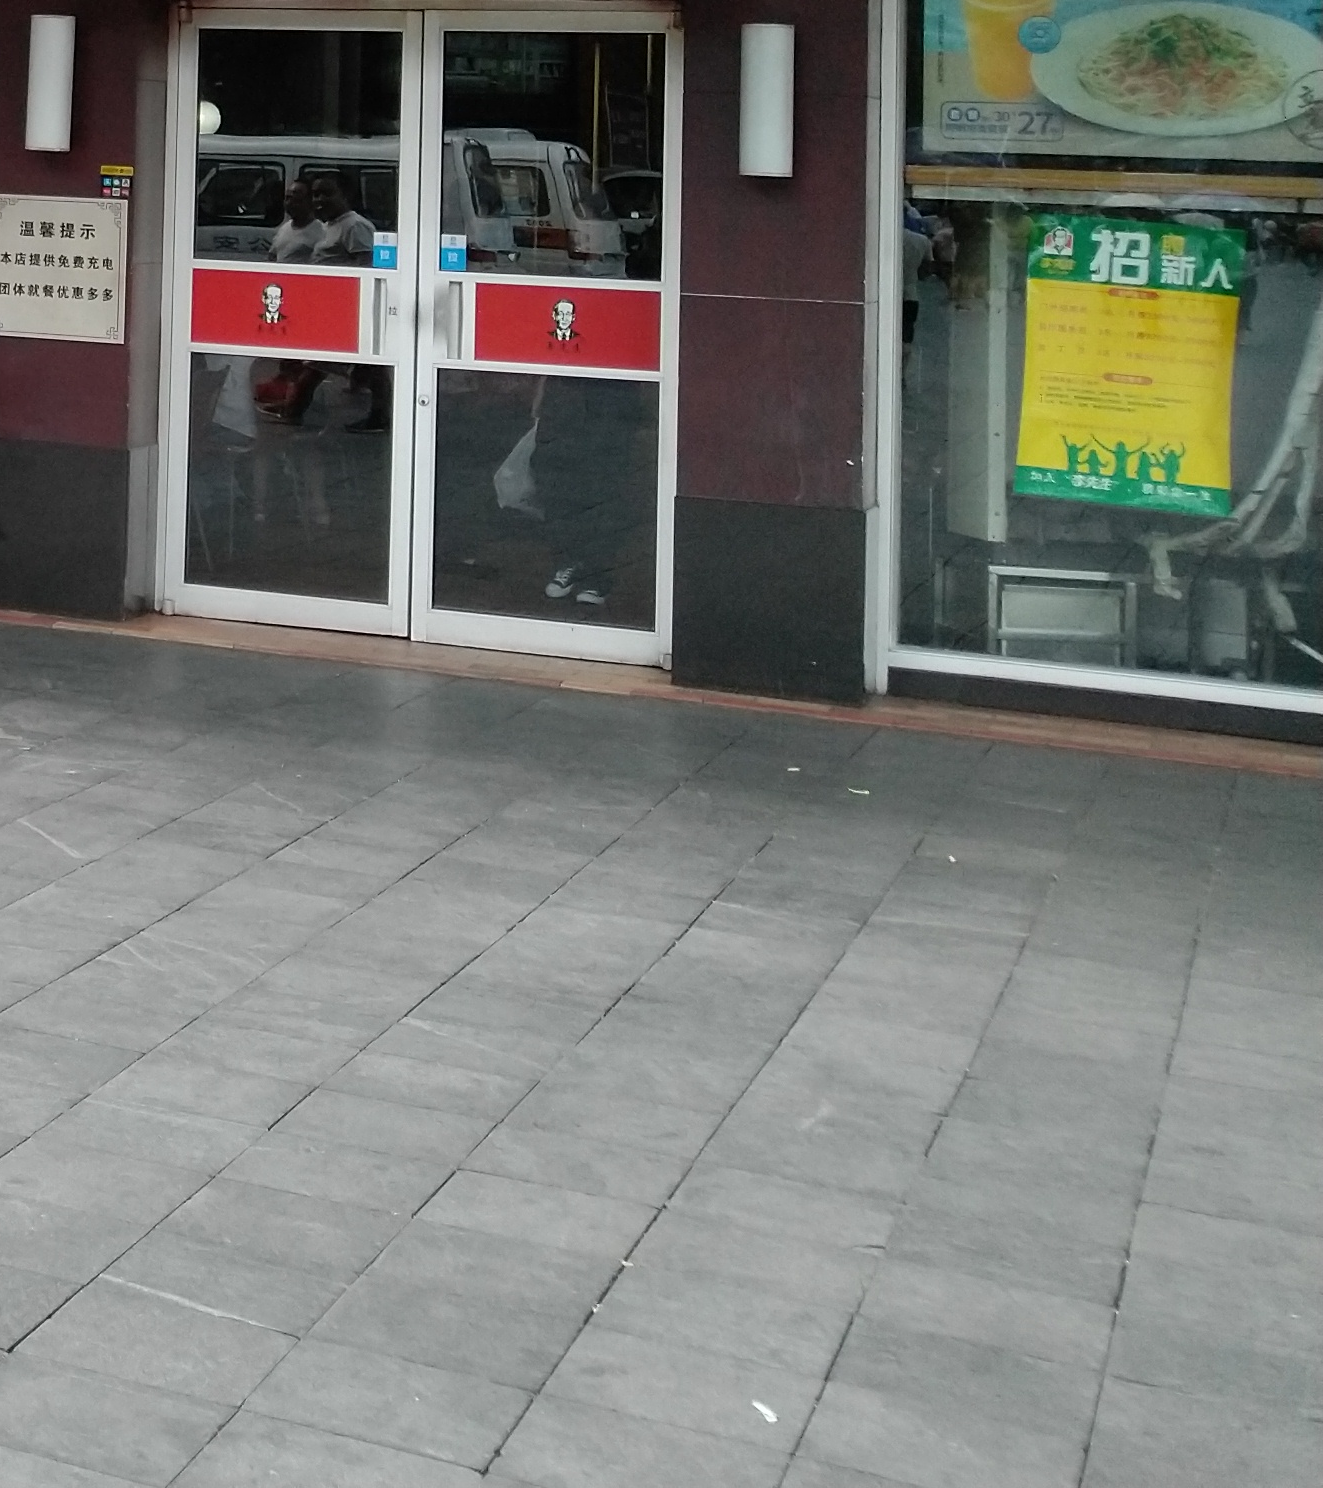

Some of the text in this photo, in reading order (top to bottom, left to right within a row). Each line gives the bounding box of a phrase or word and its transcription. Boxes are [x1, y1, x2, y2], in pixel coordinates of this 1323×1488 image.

[20, 221, 96, 240] 温馨提示
[0, 252, 114, 270] 本店提供免费充电
[1089, 230, 1150, 285] 招
